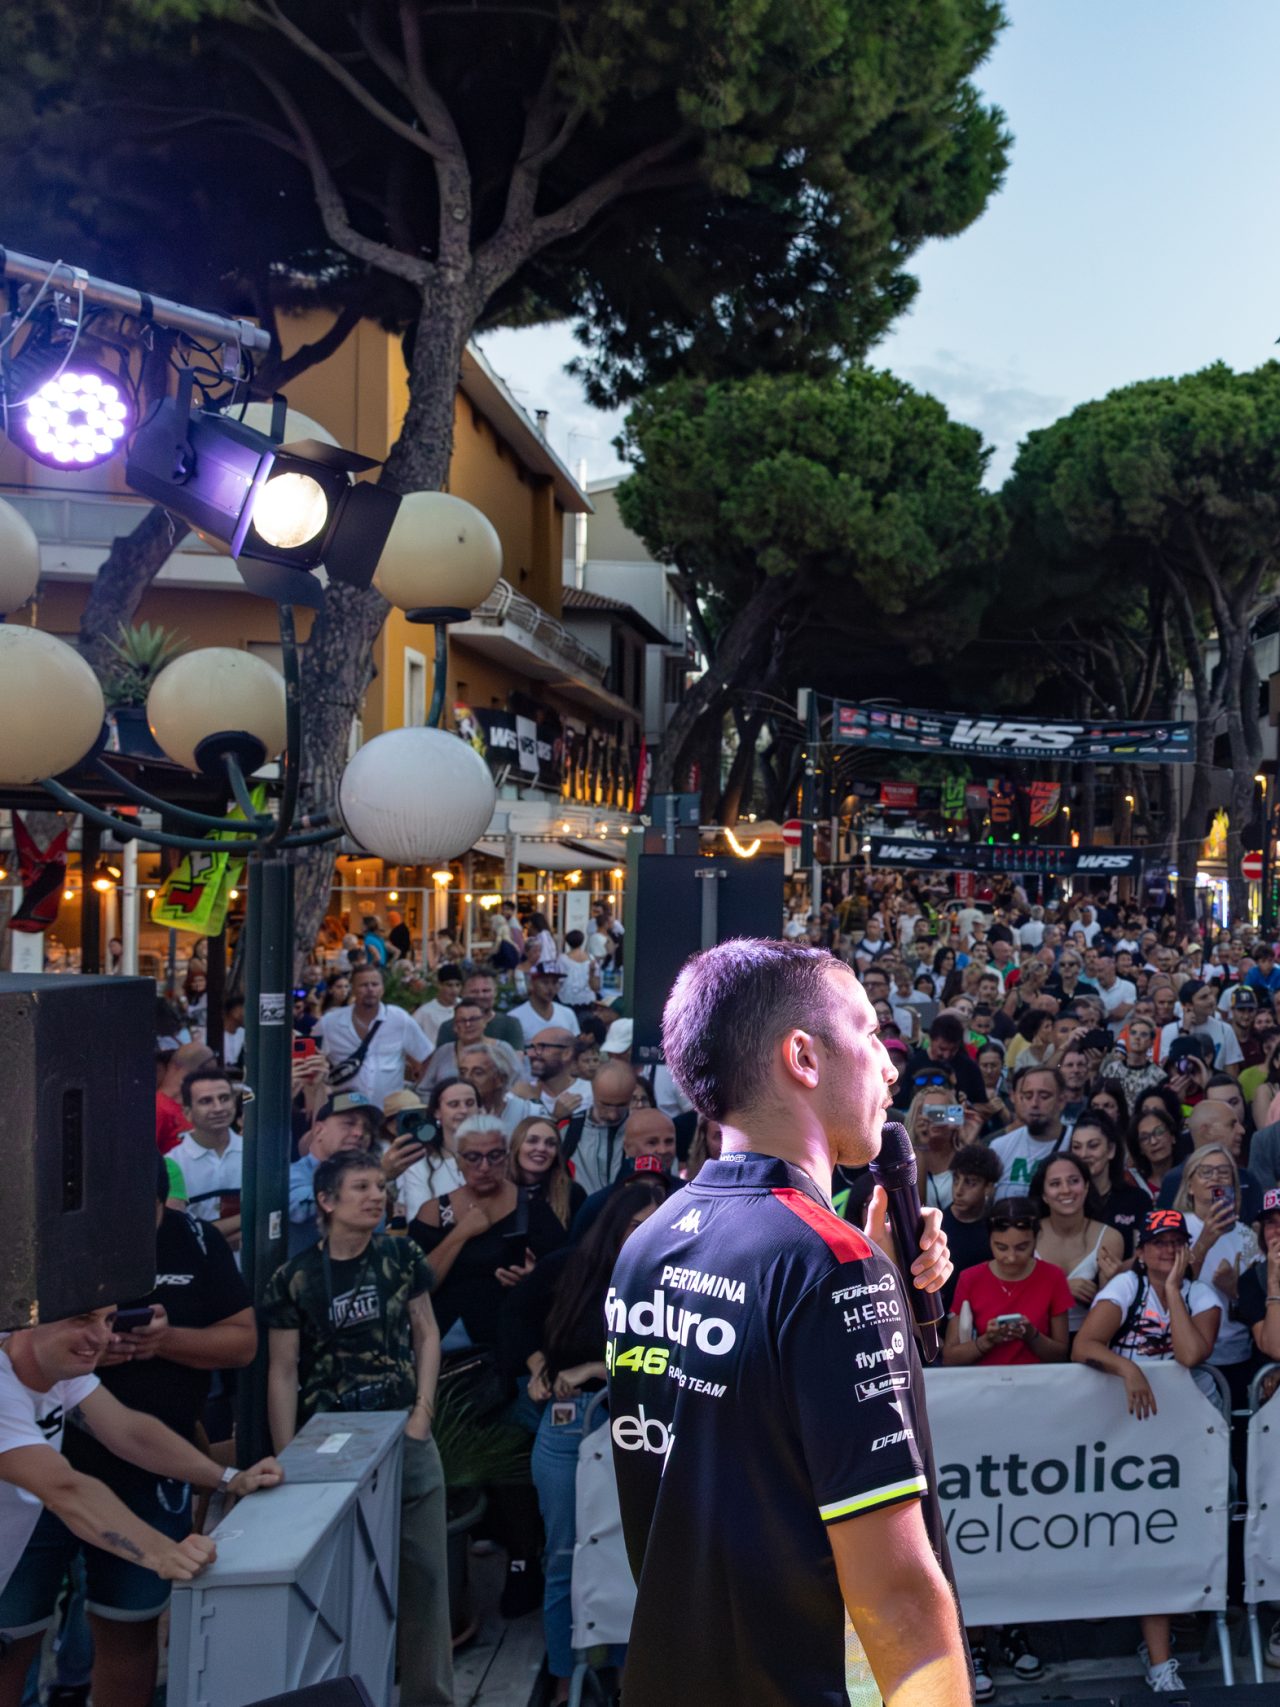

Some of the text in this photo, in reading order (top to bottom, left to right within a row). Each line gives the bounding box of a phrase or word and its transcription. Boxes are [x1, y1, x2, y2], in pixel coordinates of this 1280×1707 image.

[949, 719, 1084, 749] WRS
[878, 844, 938, 860] WRS
[1076, 855, 1134, 868] WRS
[1148, 1210, 1182, 1230] 72
[660, 1265, 746, 1304] PERTAMINA
[832, 1280, 894, 1304] TURBO
[843, 1299, 899, 1327] HERO
[688, 1376, 727, 1398] TEAM
[944, 1503, 1178, 1555] elcome
